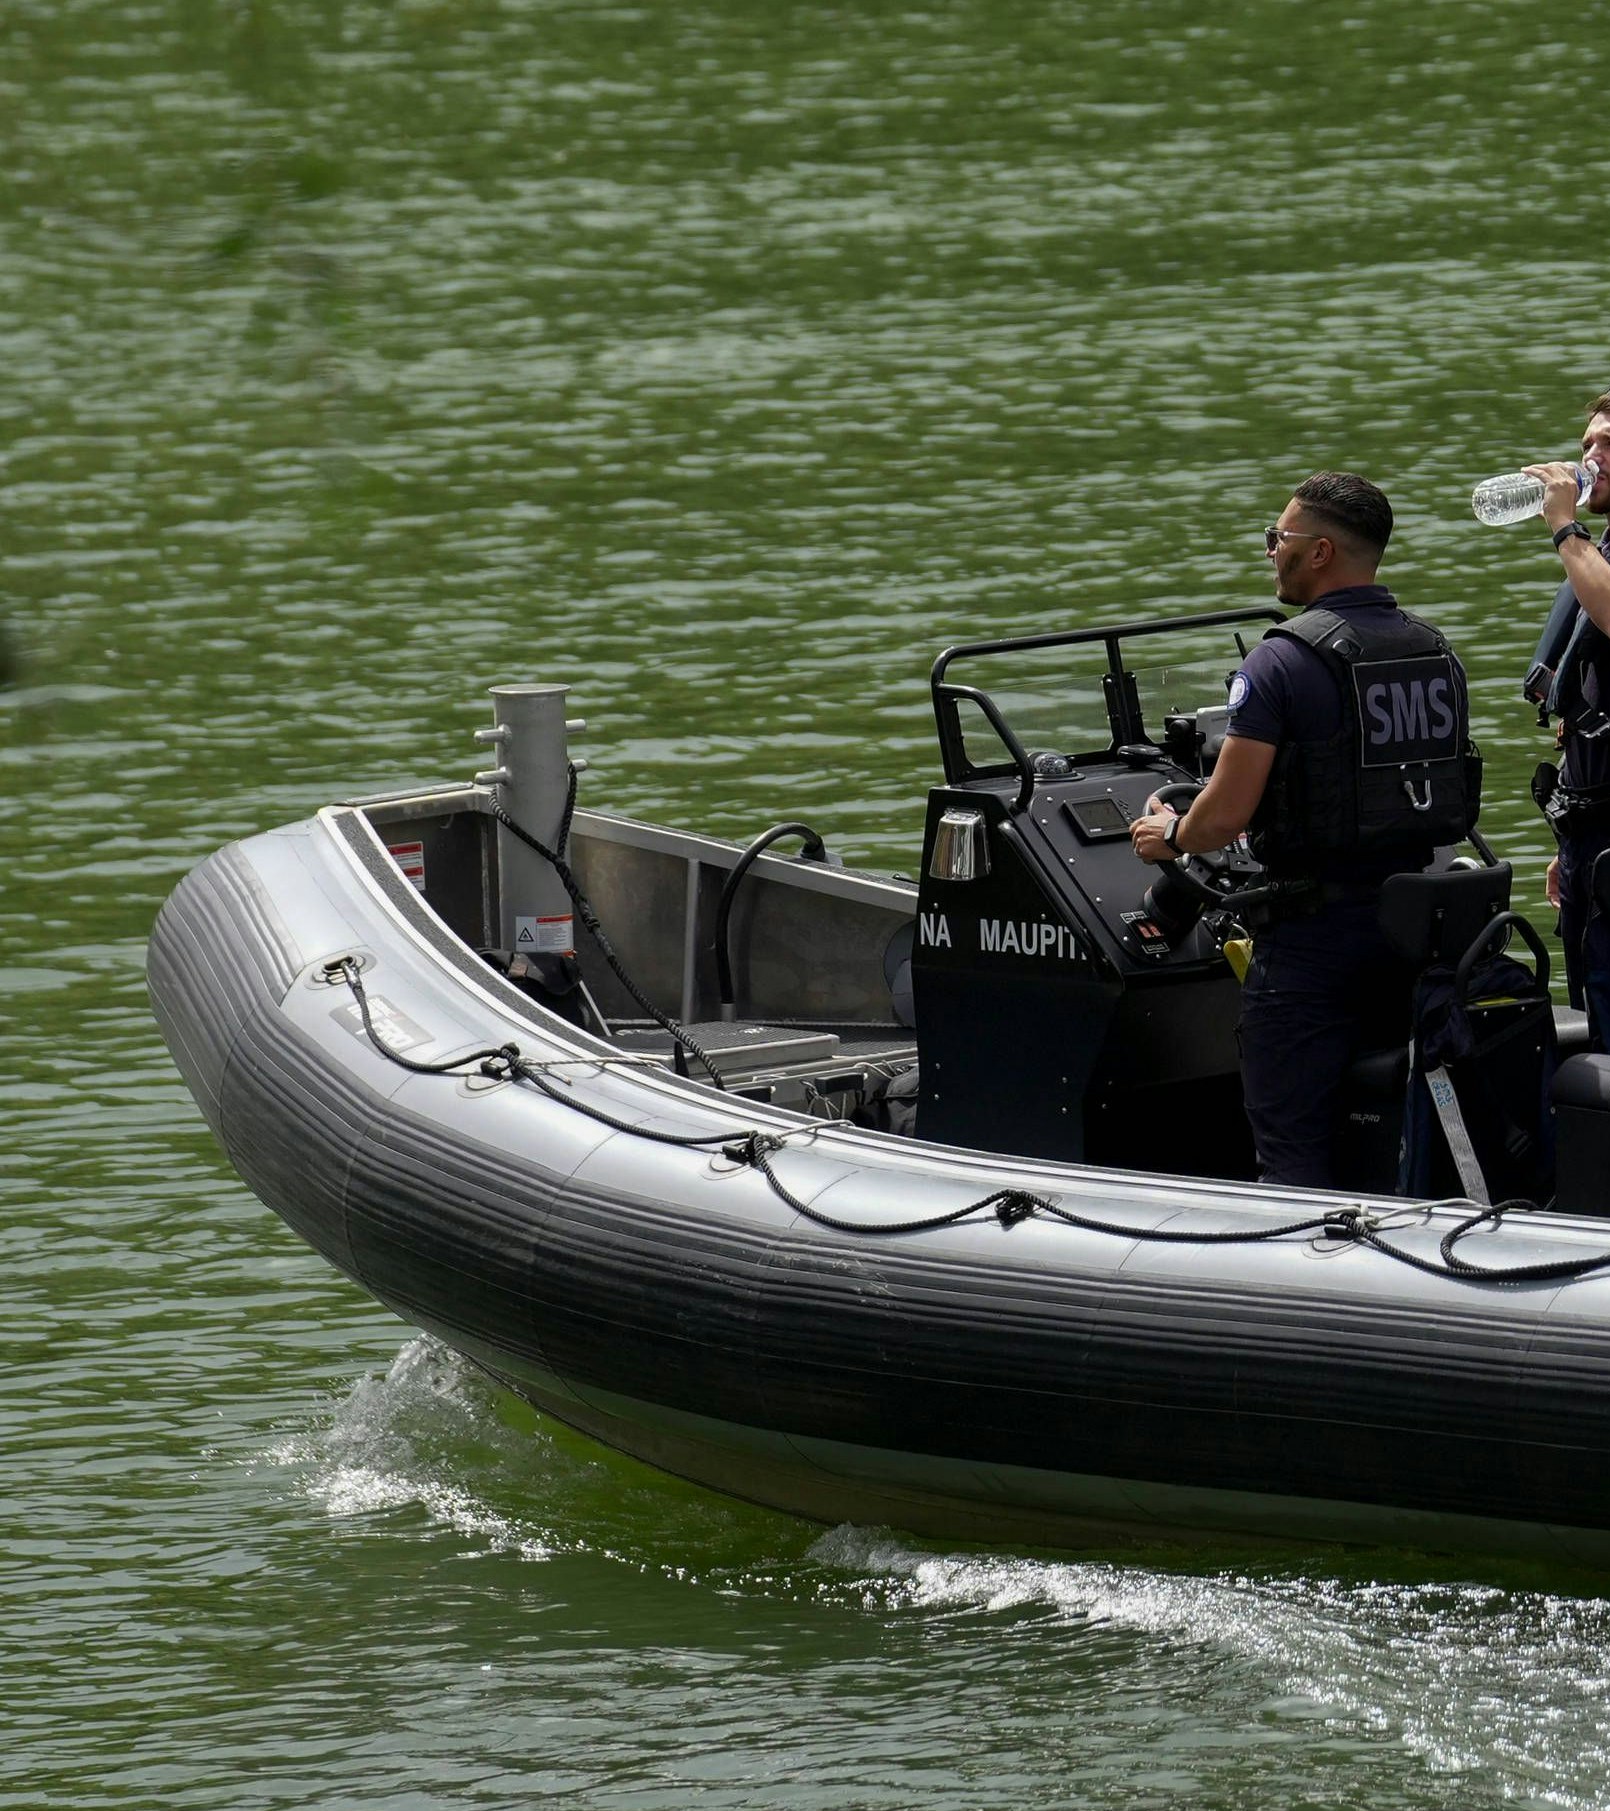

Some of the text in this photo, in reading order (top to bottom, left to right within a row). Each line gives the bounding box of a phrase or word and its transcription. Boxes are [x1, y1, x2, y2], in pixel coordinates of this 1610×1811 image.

[1366, 677, 1453, 745] SMS
[919, 912, 1088, 960] NA MAUPIT
